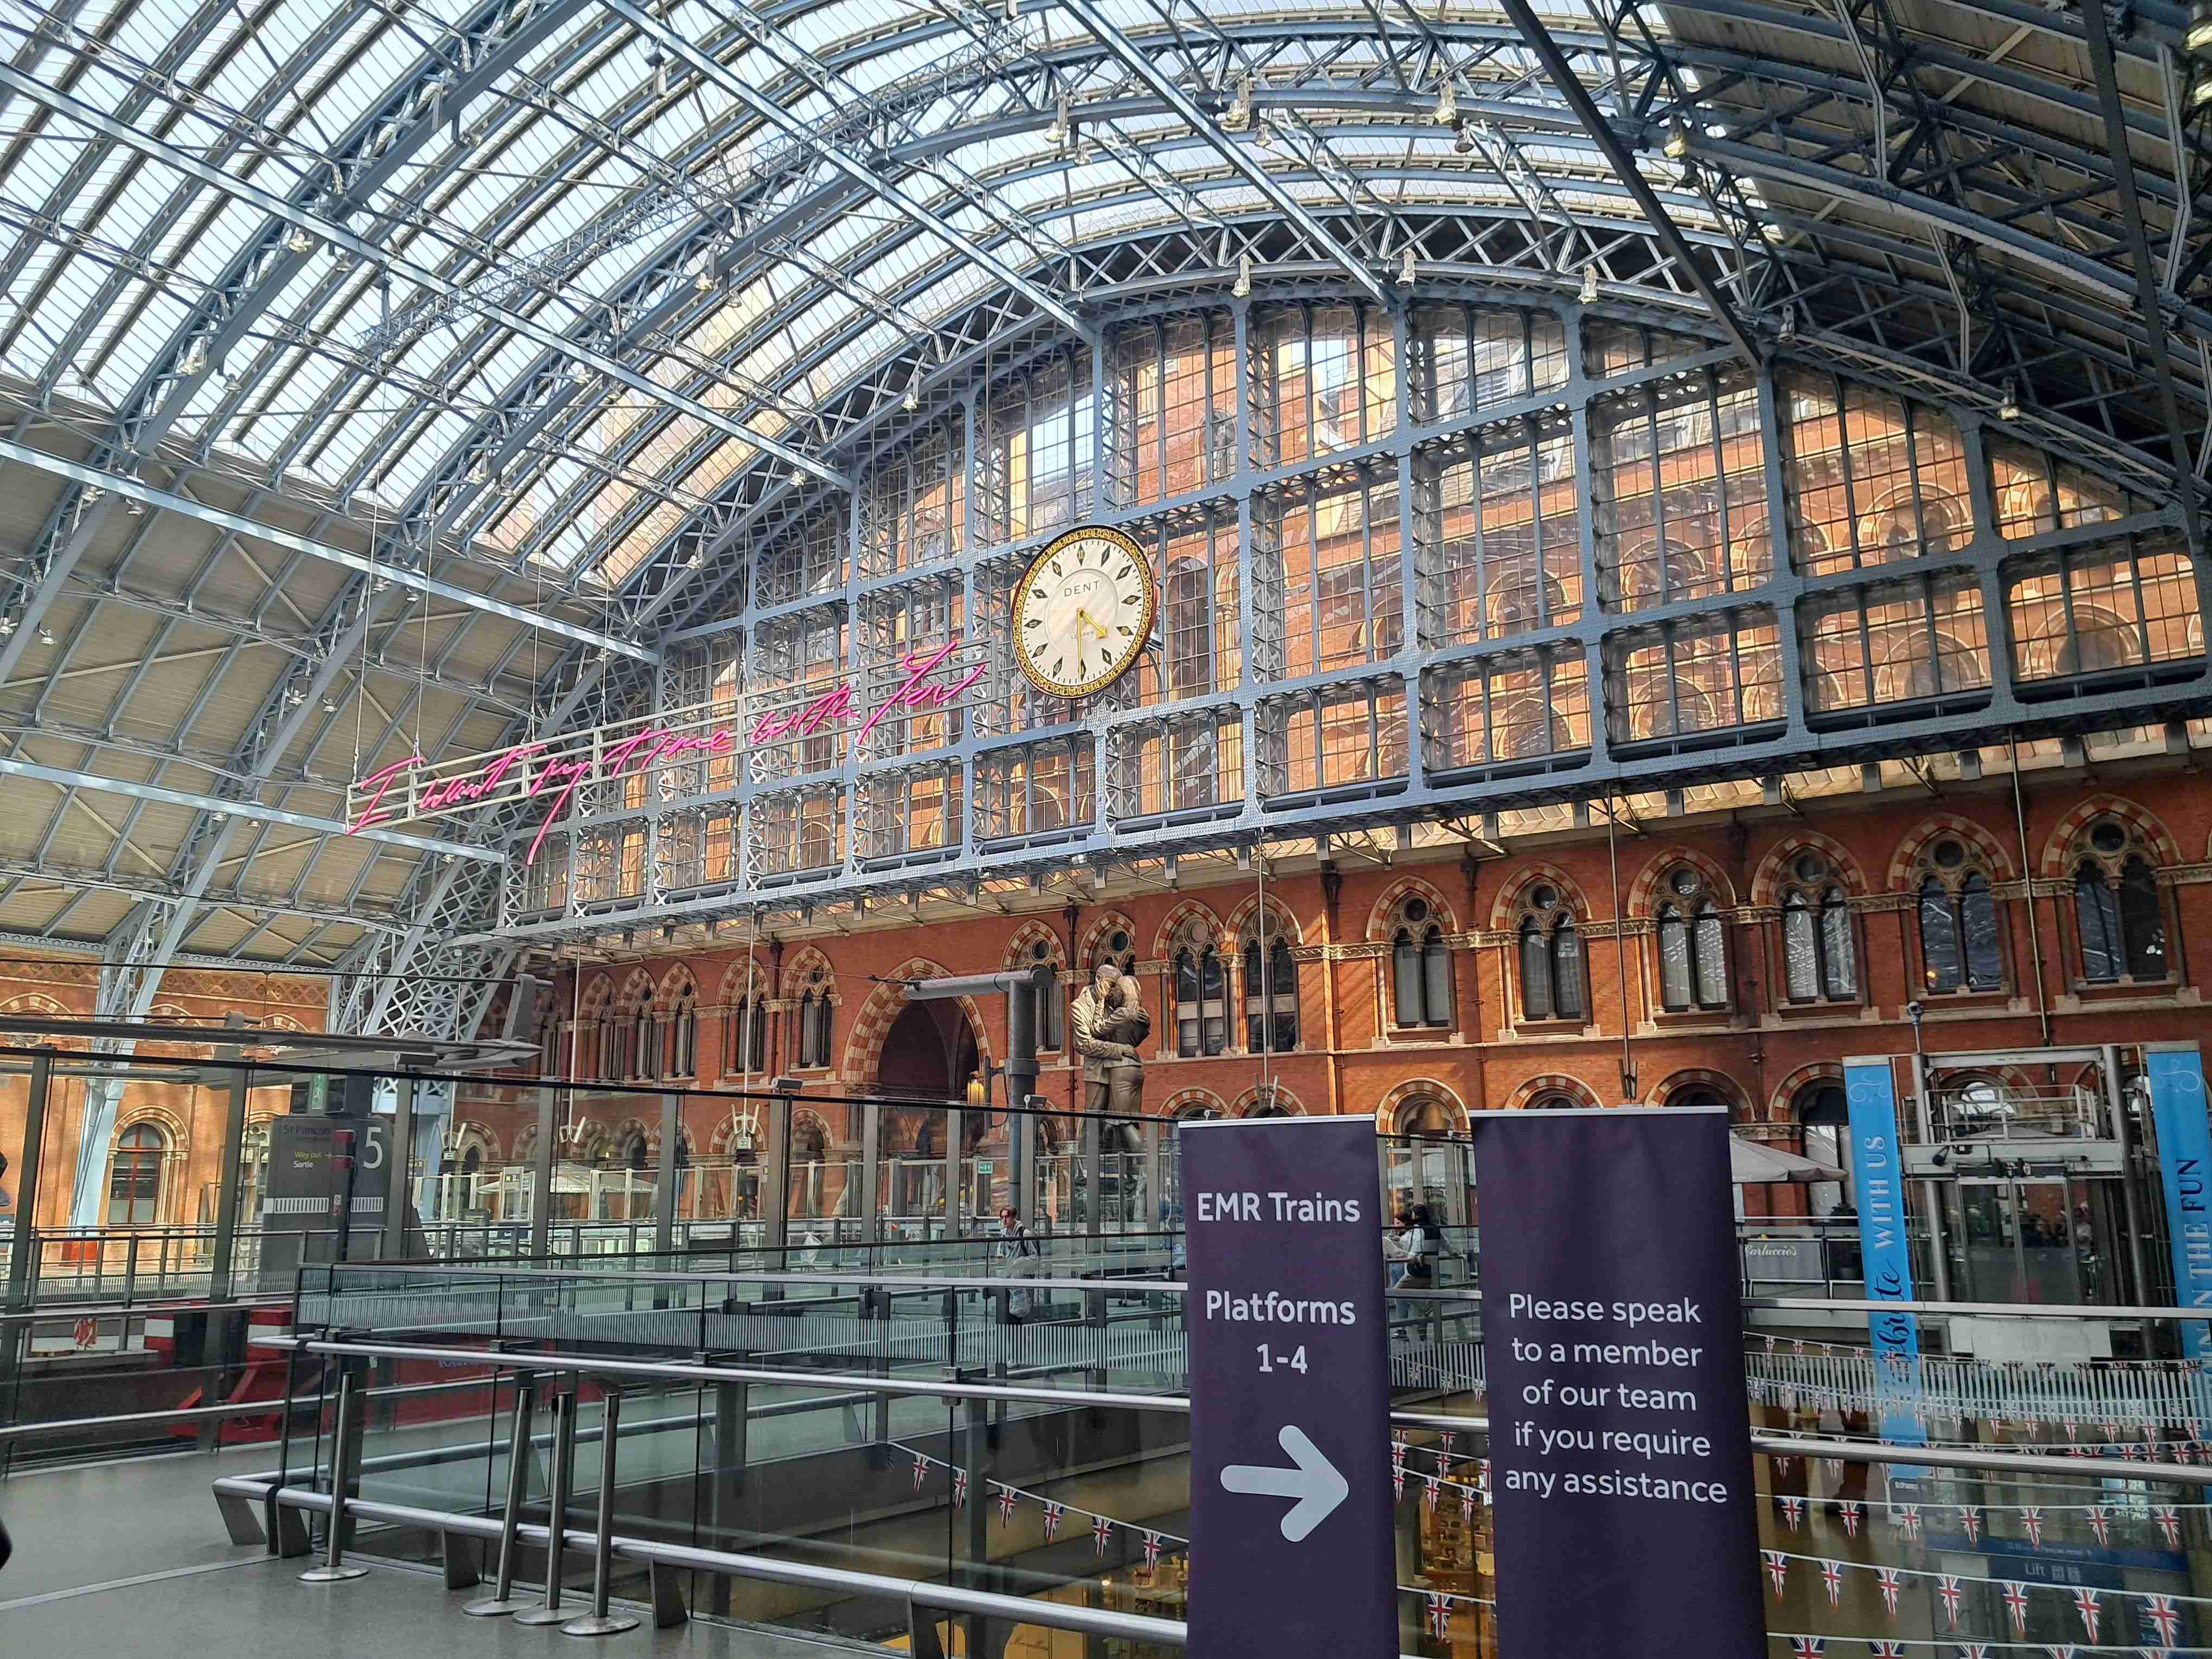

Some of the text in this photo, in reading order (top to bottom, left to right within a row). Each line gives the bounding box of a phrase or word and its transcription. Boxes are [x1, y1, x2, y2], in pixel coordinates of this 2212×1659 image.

[1064, 580, 1100, 597] DENT
[1071, 630, 1095, 640] LODON
[347, 757, 426, 835] I
[293, 1160, 314, 1168] Sortie
[294, 1150, 310, 1159] Way
[363, 1127, 383, 1169] 5
[1864, 1135, 1888, 1169] US
[2176, 1159, 2205, 1212] FUN
[1197, 1192, 1361, 1223] EMR Trains
[1868, 1178, 1895, 1250] WITH
[1206, 1290, 1356, 1325] Platforms
[1509, 1293, 1702, 1328] Please speak
[1256, 1343, 1308, 1374] 1-4
[1511, 1337, 1703, 1367] to a member
[1522, 1378, 1697, 1411] of our team
[1514, 1420, 1711, 1460] if you require
[1505, 1469, 1556, 1499] any
[1564, 1469, 1728, 1504] assistance
[2025, 1561, 2046, 1577] Lift
